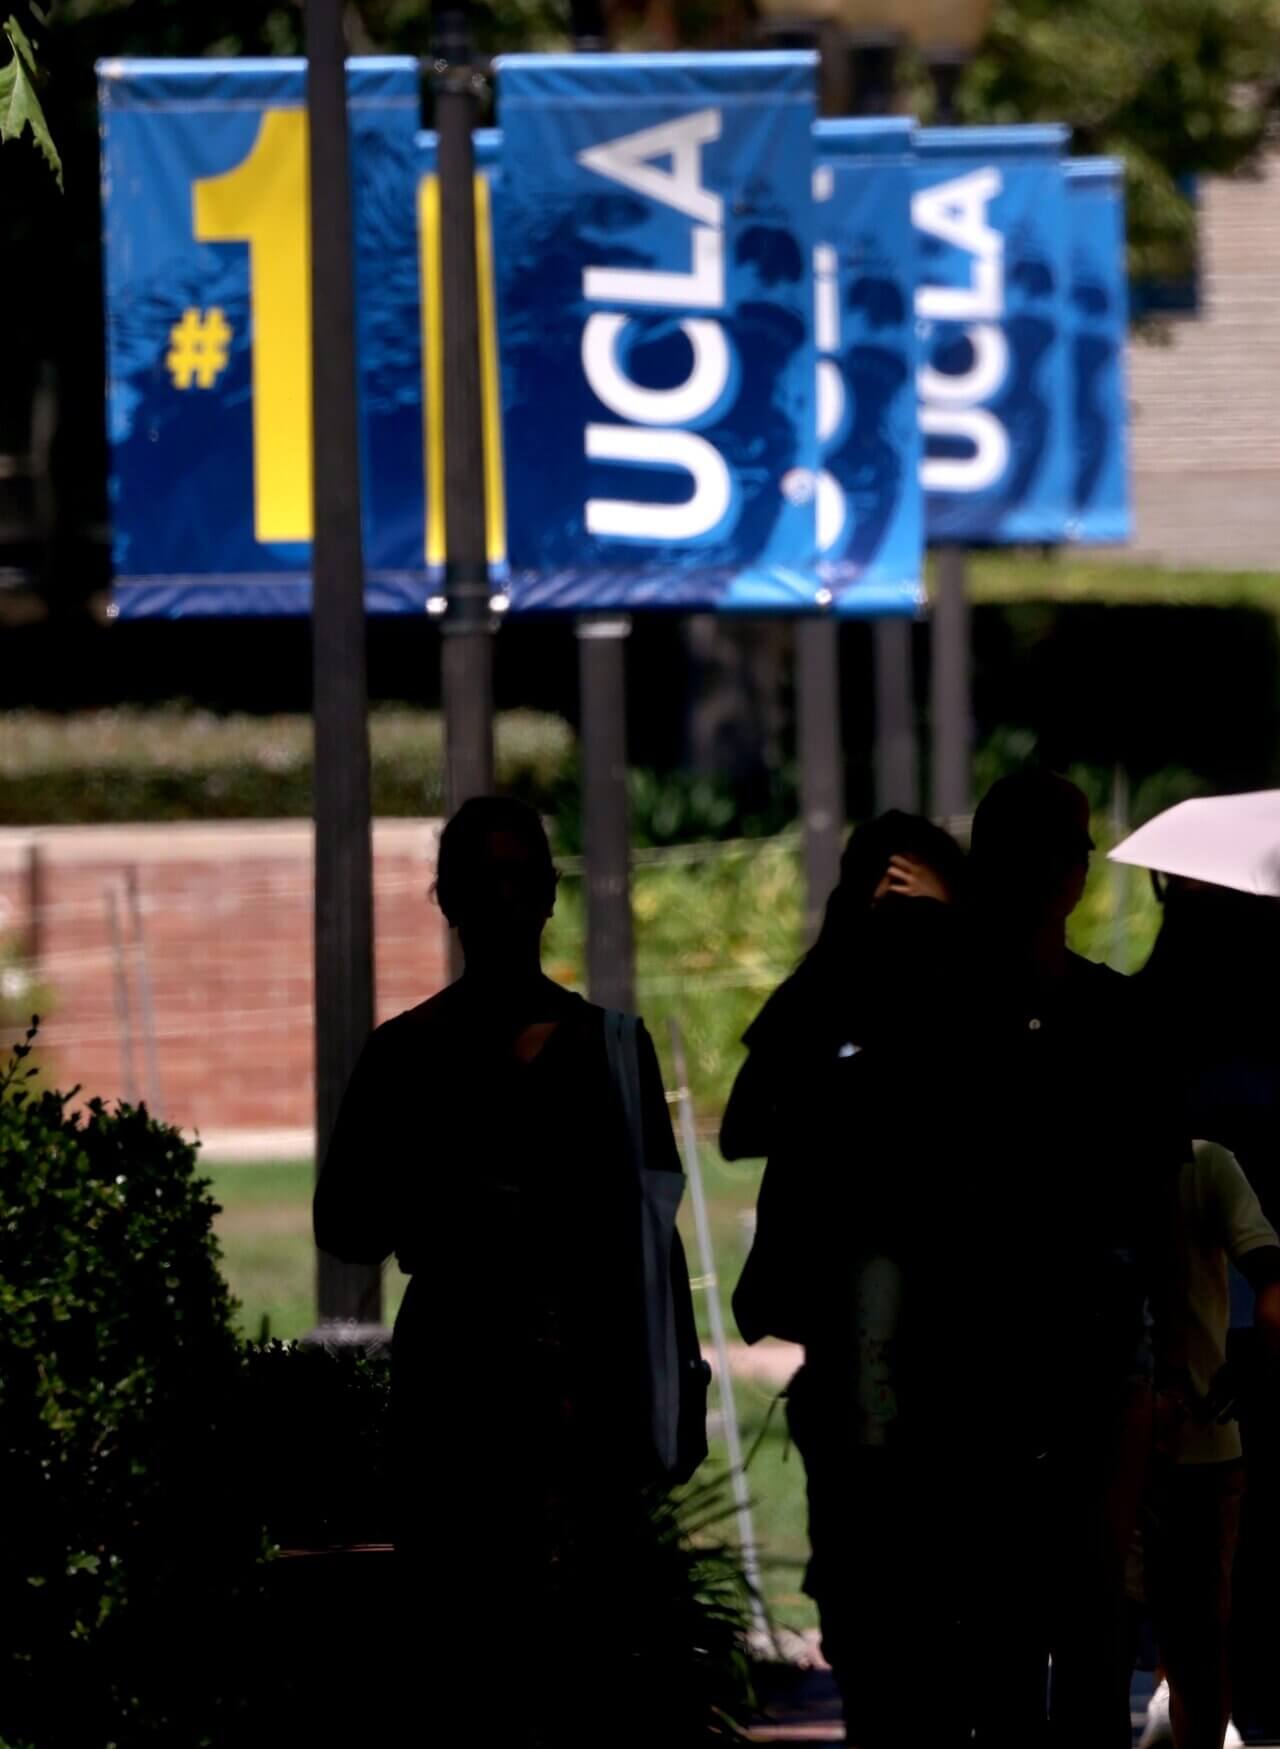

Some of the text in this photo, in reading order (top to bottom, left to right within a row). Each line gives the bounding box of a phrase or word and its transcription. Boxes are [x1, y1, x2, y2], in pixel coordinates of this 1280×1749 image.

[165, 107, 314, 542] #1
[577, 108, 731, 540] UCLA
[910, 166, 1010, 492] UCLA
